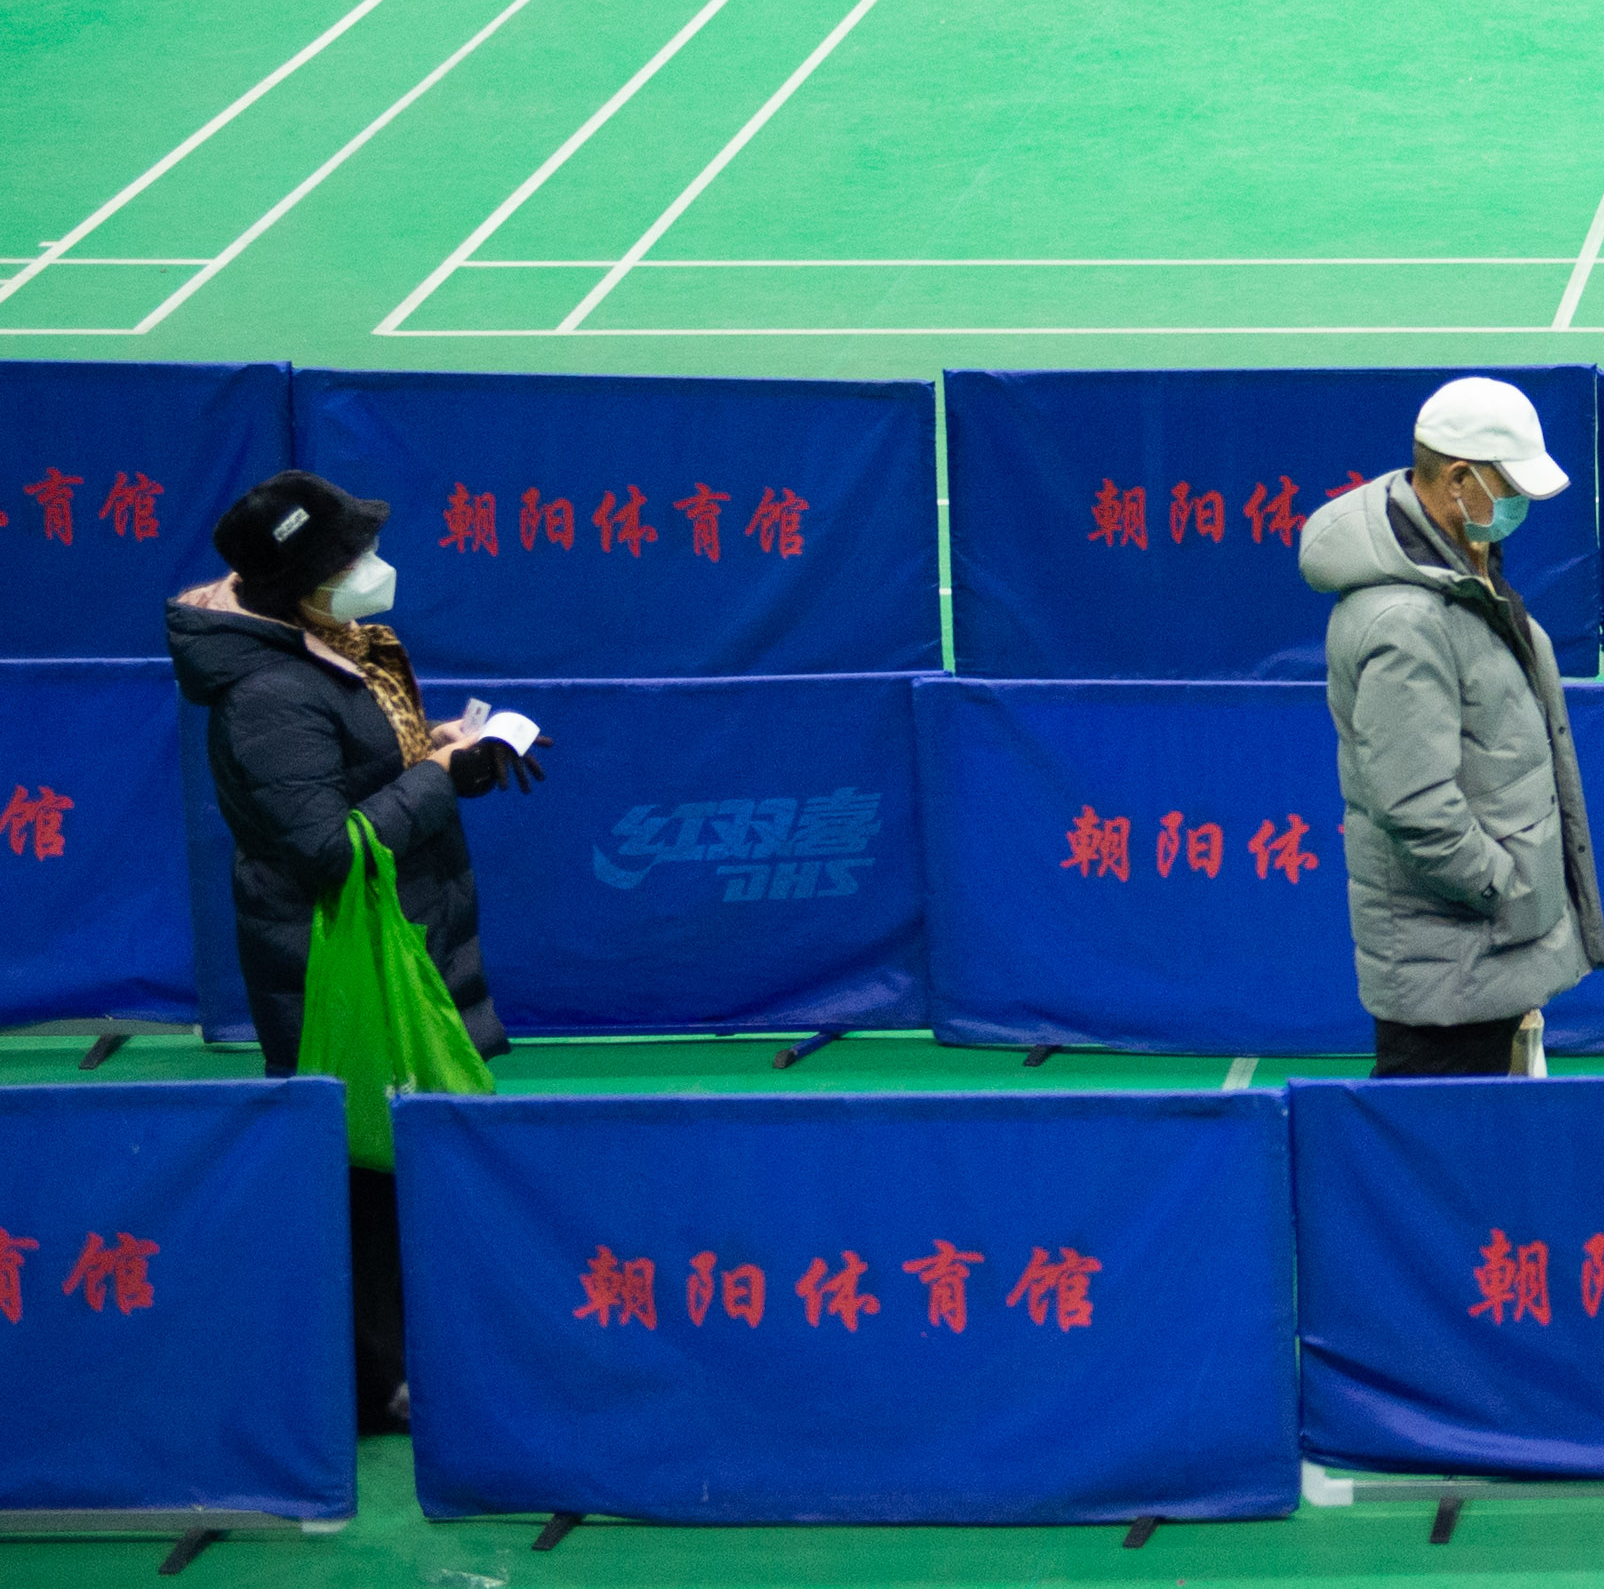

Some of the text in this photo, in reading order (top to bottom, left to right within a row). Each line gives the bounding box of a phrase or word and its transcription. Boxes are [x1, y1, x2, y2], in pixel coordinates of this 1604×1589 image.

[0, 468, 164, 545] 育馆
[438, 481, 810, 561] 朝阳体育馆
[1087, 470, 1366, 550] 朝阳体
[606, 786, 883, 859] 红双喜
[1060, 805, 1346, 884] 朝阳体
[716, 858, 877, 903] DHS
[573, 1239, 1102, 1334] 朝阳体育馆
